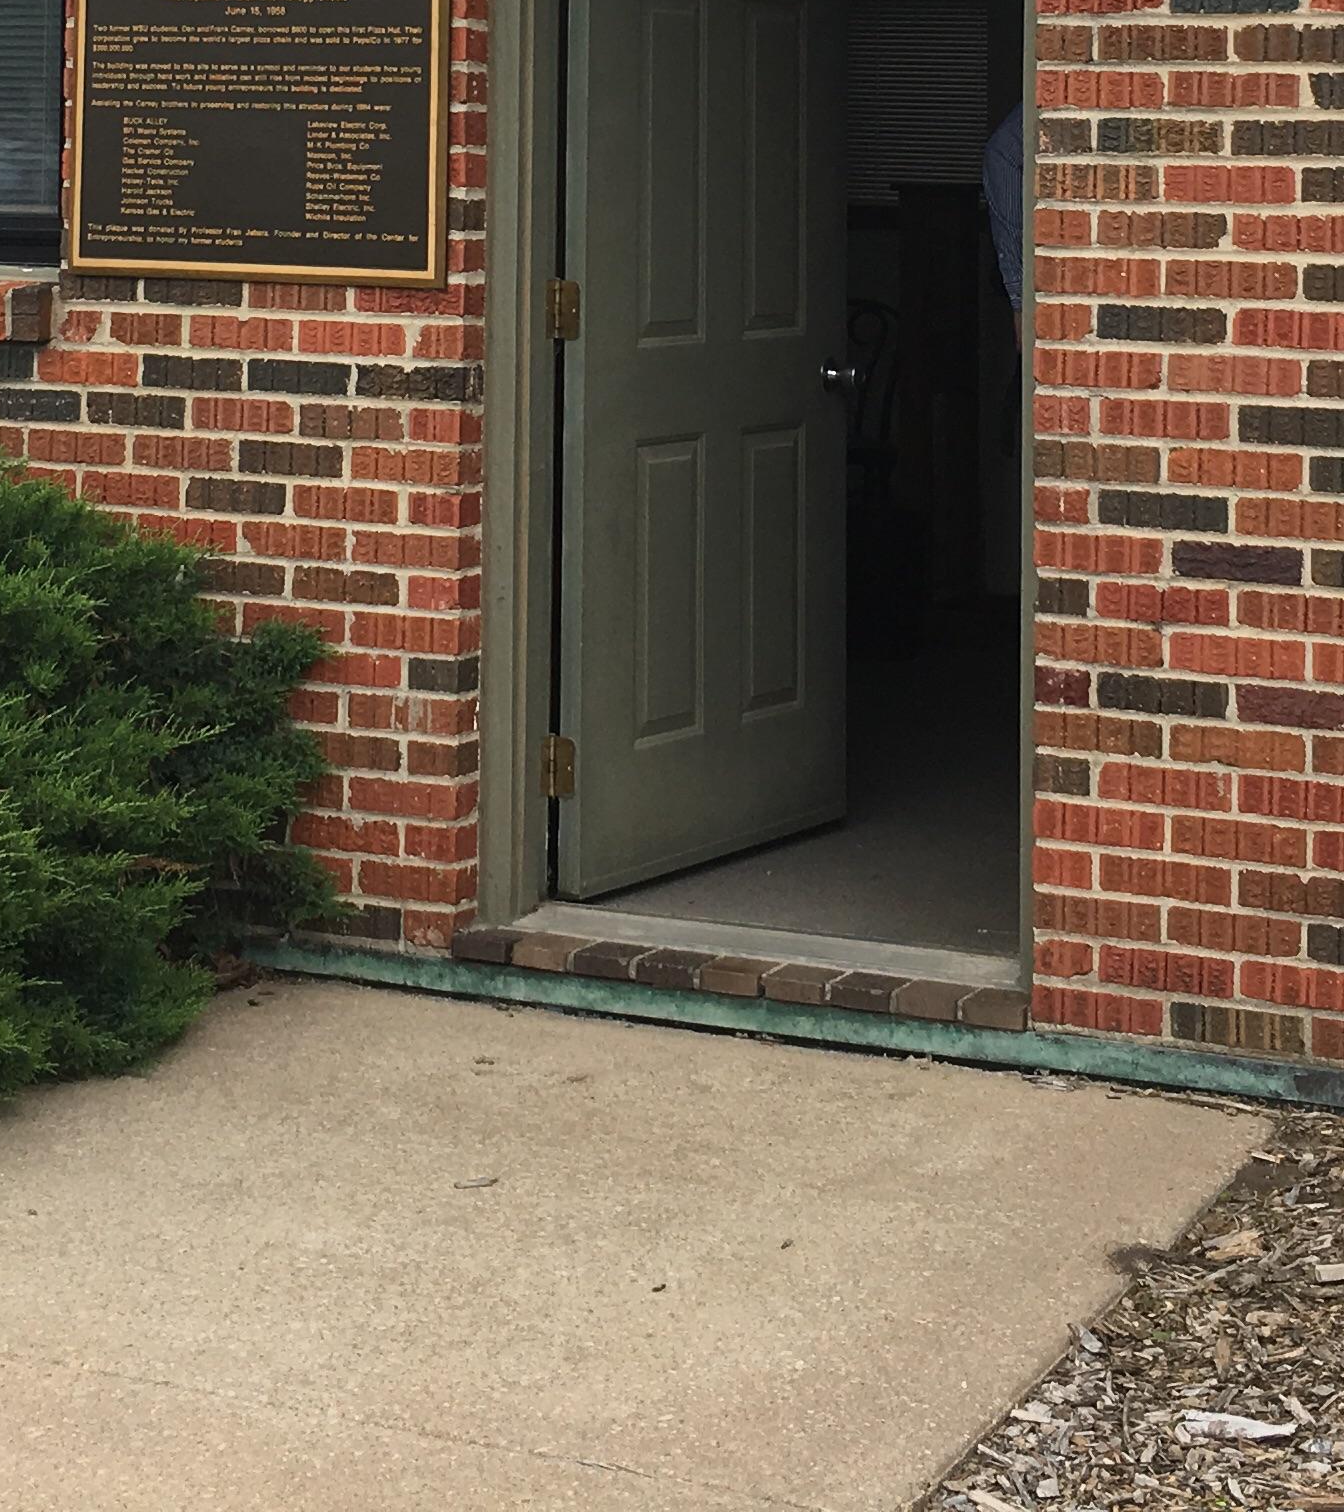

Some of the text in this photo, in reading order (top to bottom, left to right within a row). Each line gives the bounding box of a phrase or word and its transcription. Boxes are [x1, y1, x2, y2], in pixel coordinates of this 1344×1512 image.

[225, 6, 286, 16] June 15, 1958
